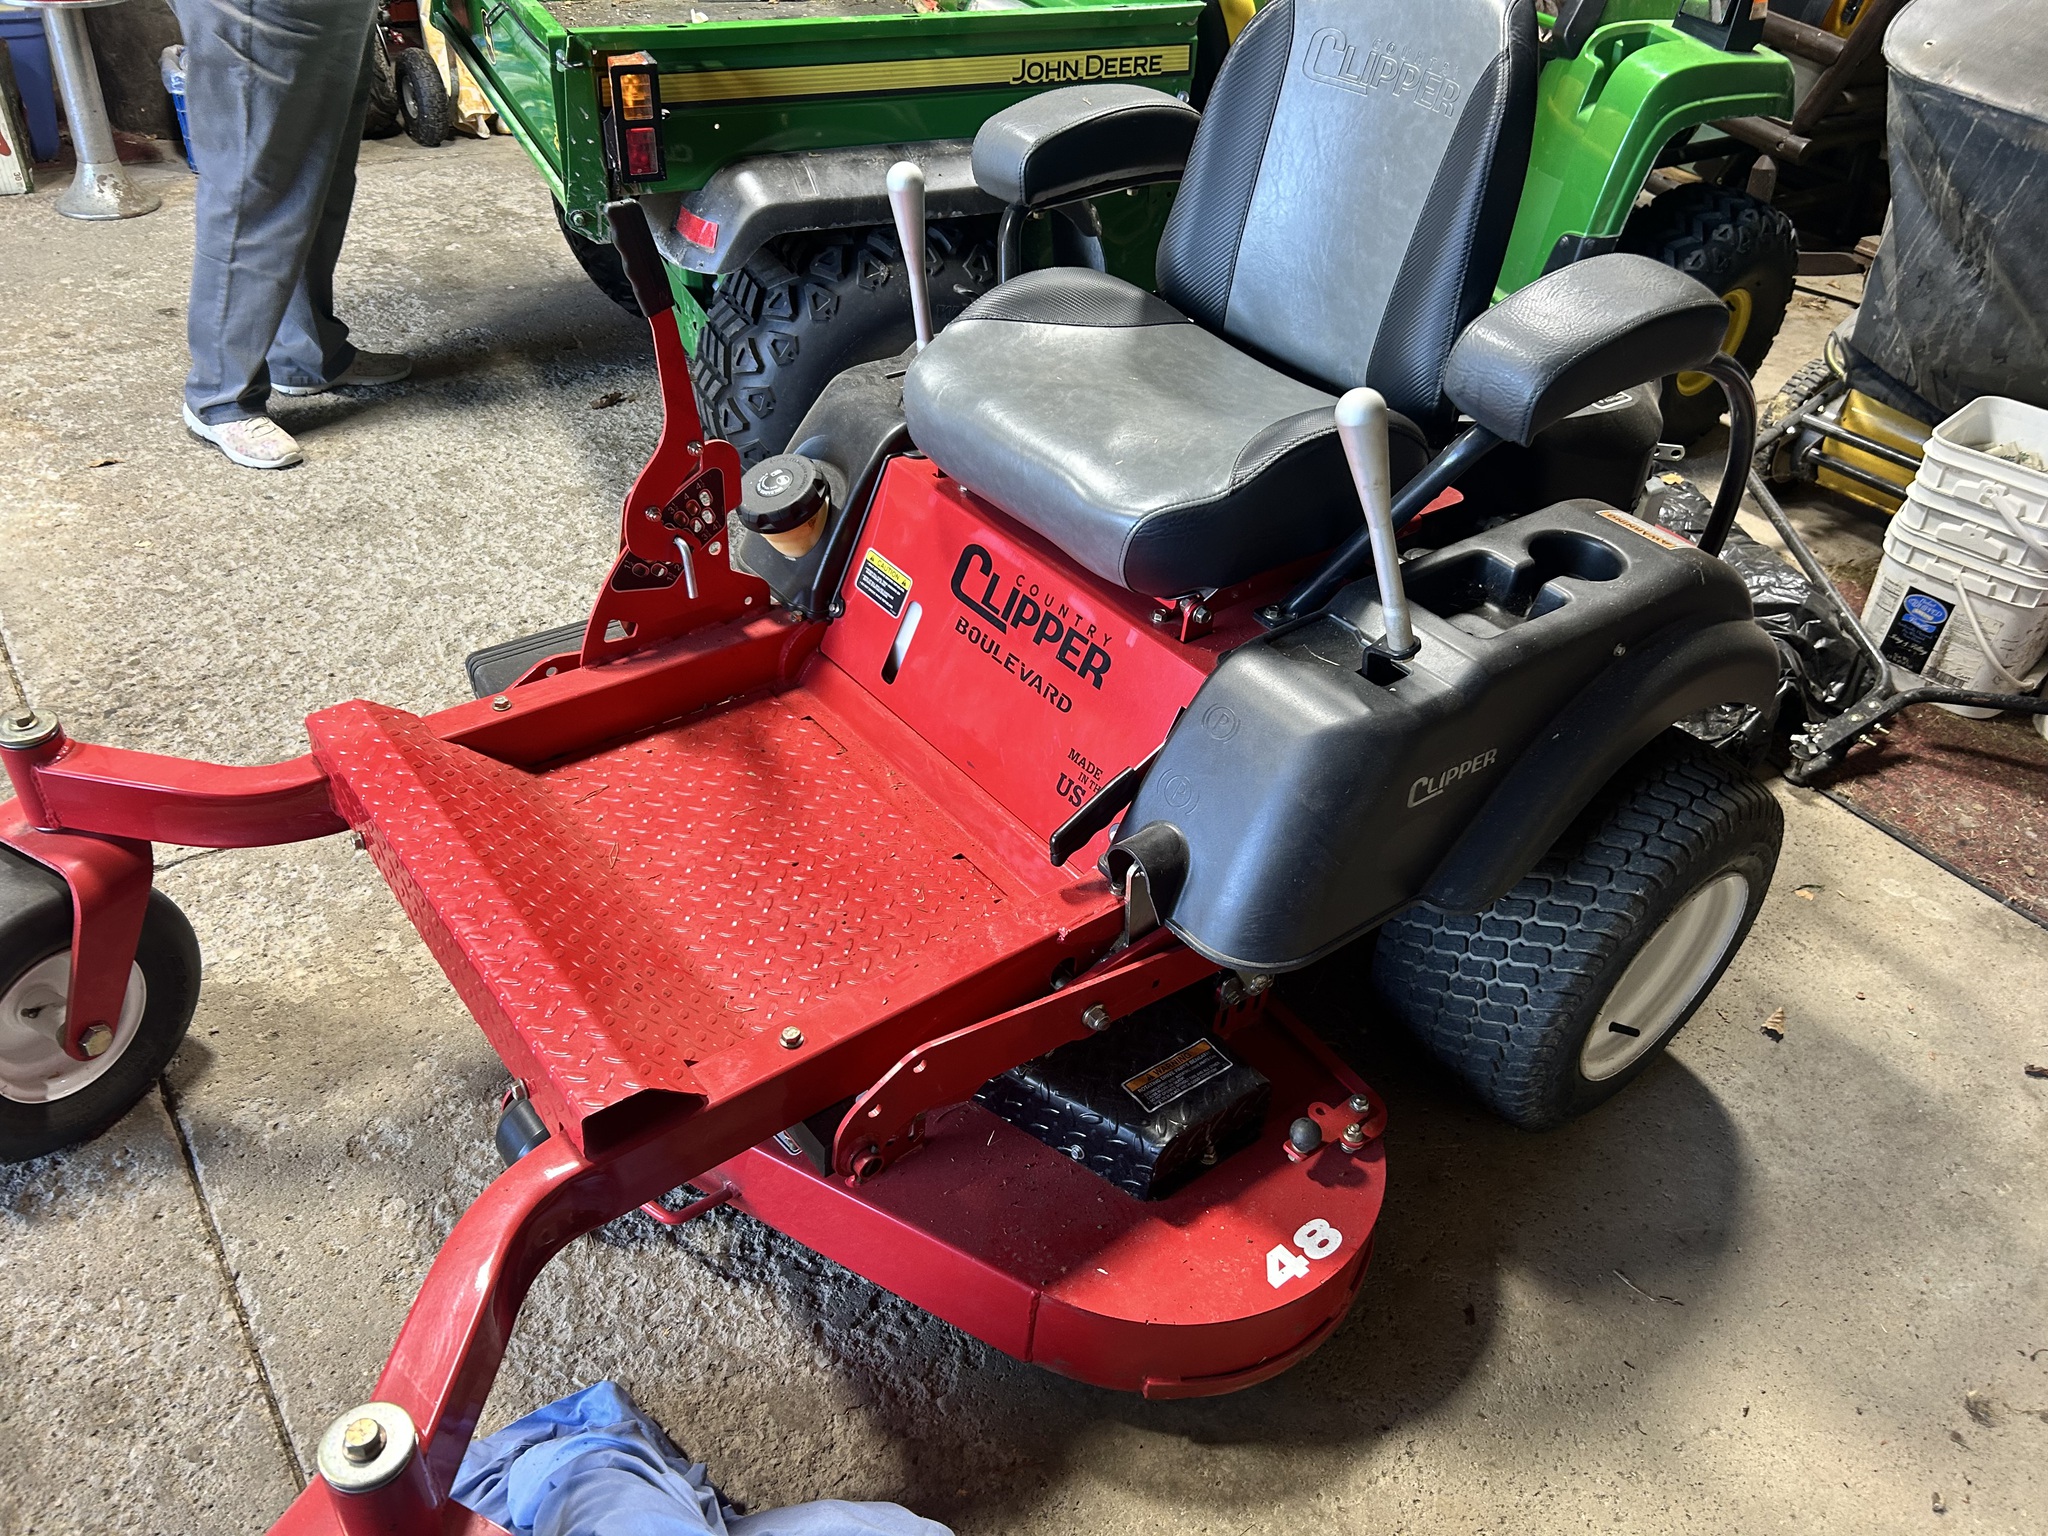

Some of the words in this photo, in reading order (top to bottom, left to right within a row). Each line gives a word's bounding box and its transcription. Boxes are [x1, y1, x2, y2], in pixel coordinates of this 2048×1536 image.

[1011, 59, 1079, 82] JOHN
[1085, 55, 1163, 76] DEERE
[1302, 26, 1461, 119] CLIPPER
[876, 560, 900, 581] CAUTION
[951, 543, 1112, 691] CLIPPER
[1016, 575, 1112, 647] COUNTRY
[955, 616, 1073, 713] BOULEVARD
[1067, 748, 1103, 781] MADE
[1078, 772, 1089, 785] IN
[1089, 780, 1102, 793] TH
[1407, 748, 1497, 808] CLIPPER
[1056, 772, 1087, 808] US
[1152, 1052, 1192, 1075] WARNING
[1266, 1218, 1342, 1289] 48
